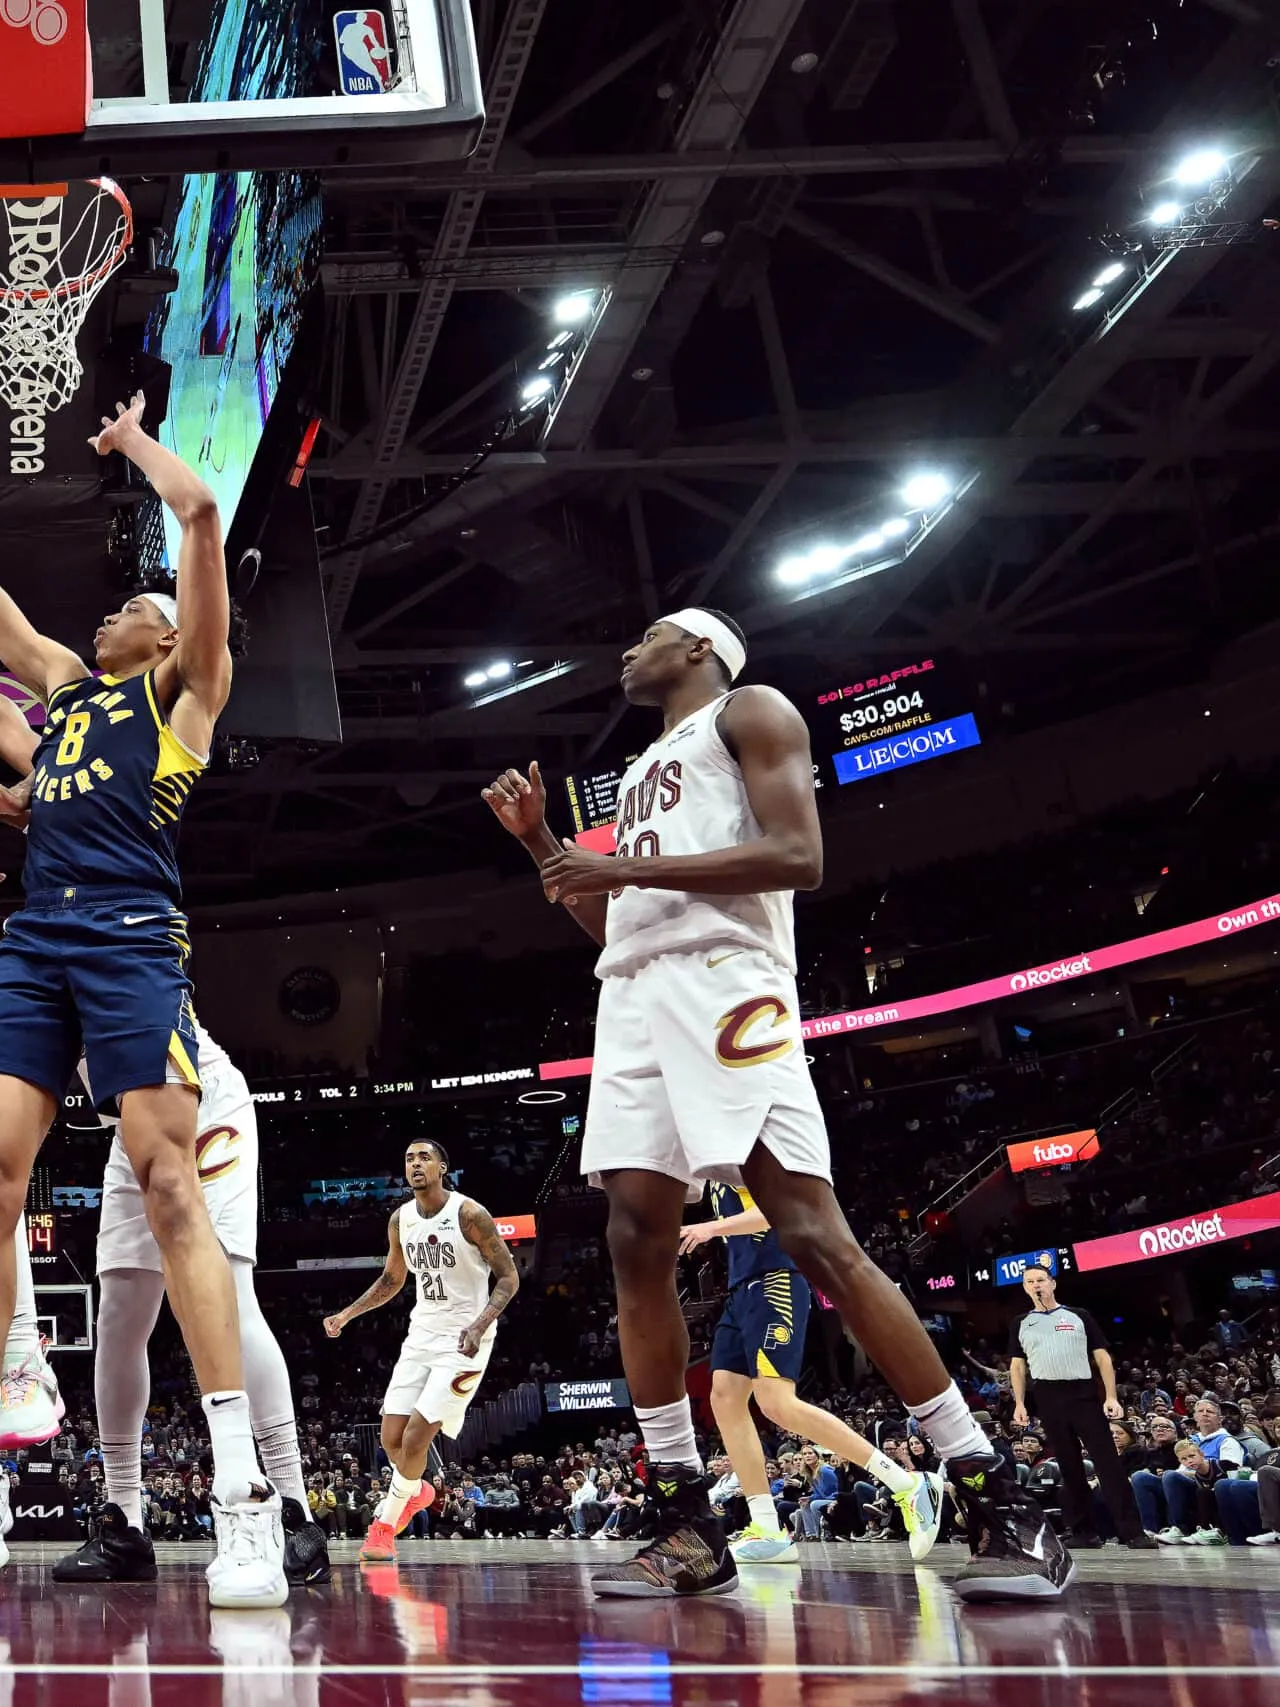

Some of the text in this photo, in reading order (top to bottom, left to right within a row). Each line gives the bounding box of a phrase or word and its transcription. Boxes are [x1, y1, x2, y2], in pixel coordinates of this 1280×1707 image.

[348, 77, 374, 91] NBA
[865, 659, 936, 690] RAFFLE
[839, 690, 925, 733] $30,904
[55, 711, 91, 766] 8
[843, 712, 933, 747] CAVS.COM/RAFFLE
[617, 759, 683, 846] AVS
[1217, 902, 1280, 934] Own th
[1026, 956, 1092, 988] Rocket
[814, 1015, 842, 1034] the
[844, 1006, 899, 1029] Dream
[431, 1075, 461, 1089] LET
[483, 1068, 535, 1085] KNOW.
[64, 1095, 84, 1108] OT
[250, 1090, 285, 1103] FOULS
[293, 1089, 303, 1102] 2
[319, 1087, 342, 1099] TOL
[349, 1085, 358, 1098] 2
[373, 1082, 398, 1095] 3:34
[398, 1081, 415, 1093] PM
[1032, 1143, 1074, 1163] fubo
[28, 1214, 53, 1228] 1:46
[1157, 1212, 1227, 1251] Rocket
[28, 1227, 51, 1252] 14
[29, 1256, 58, 1264] ISSOT
[405, 1241, 457, 1269] CAVS
[1061, 1257, 1071, 1270] 2
[420, 1271, 448, 1301] 21
[926, 1274, 956, 1291] 1:46
[975, 1269, 990, 1282] 14
[559, 1381, 612, 1397] SHERWIN
